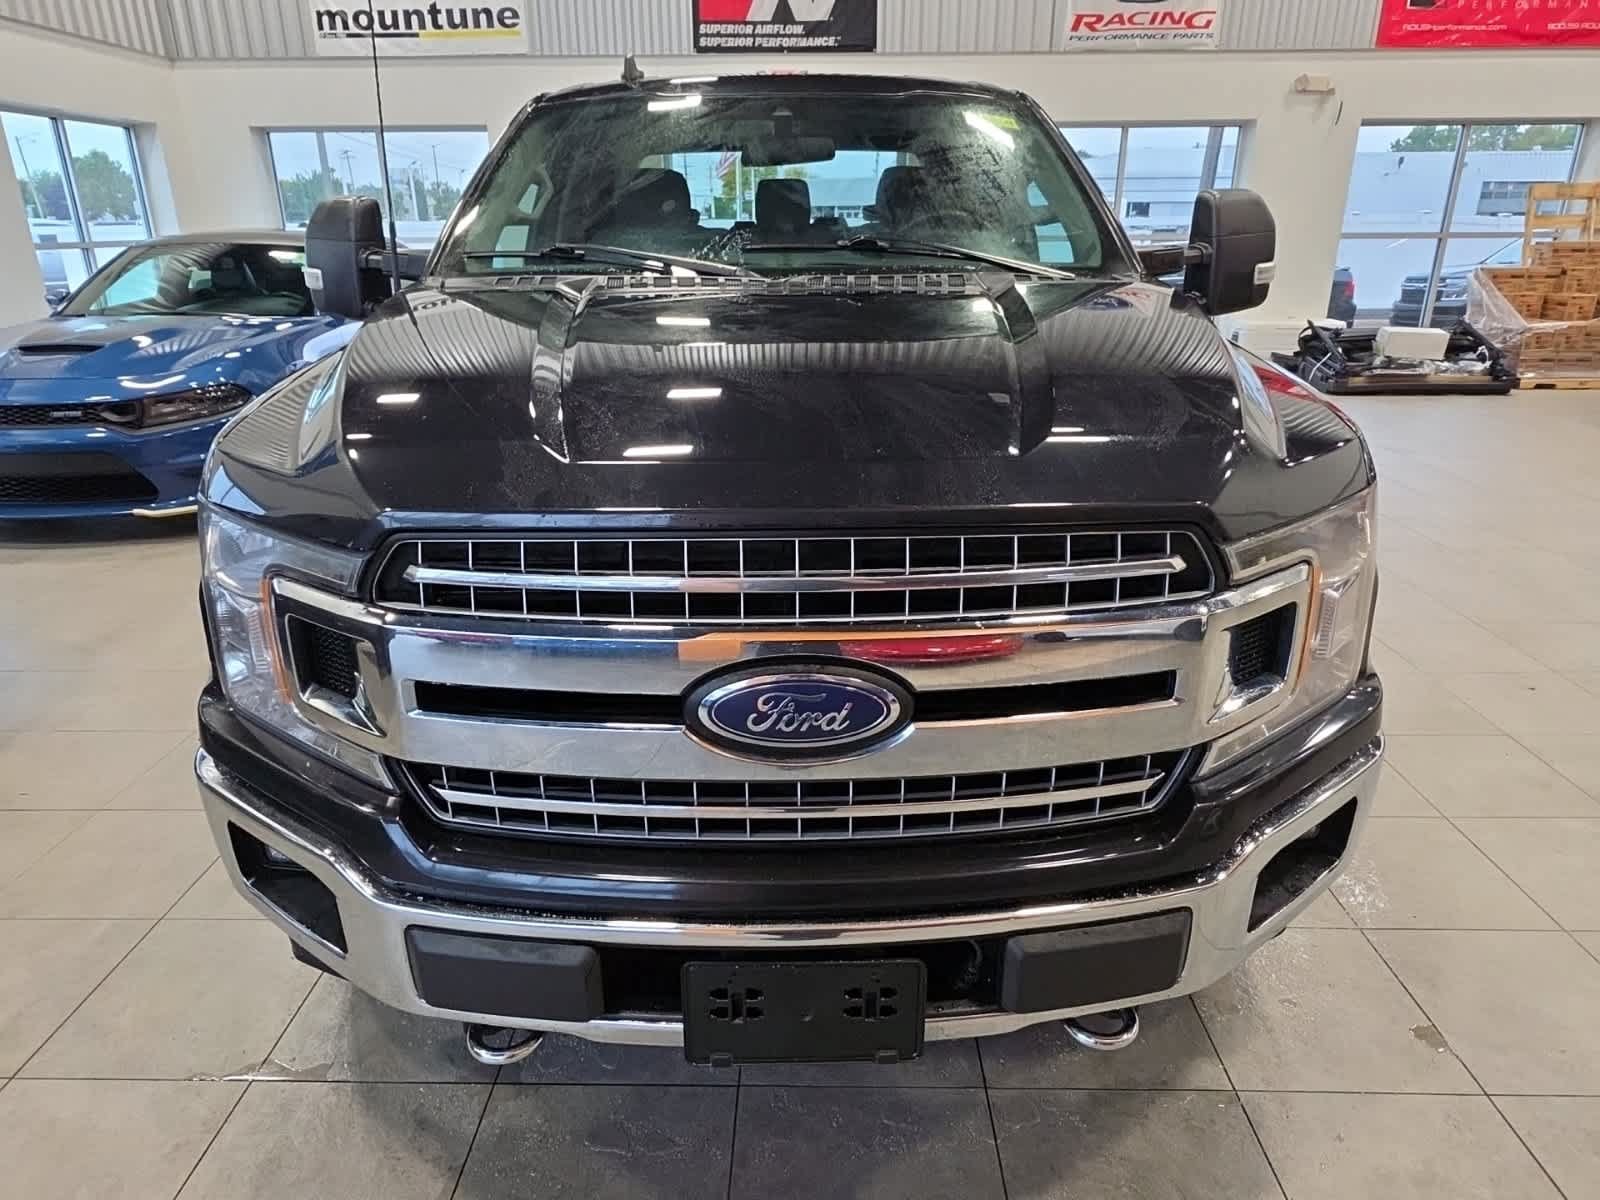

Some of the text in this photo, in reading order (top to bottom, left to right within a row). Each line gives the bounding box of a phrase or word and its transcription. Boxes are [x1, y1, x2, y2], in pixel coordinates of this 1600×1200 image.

[315, 2, 521, 32] mountune
[1070, 10, 1216, 33] RACING
[699, 24, 806, 35] SUPERIOR AIRFLOW.
[1069, 31, 1215, 42] PERFORMANCE PARTS
[699, 37, 754, 48] SUPERIOR
[746, 692, 853, 733] Ford
